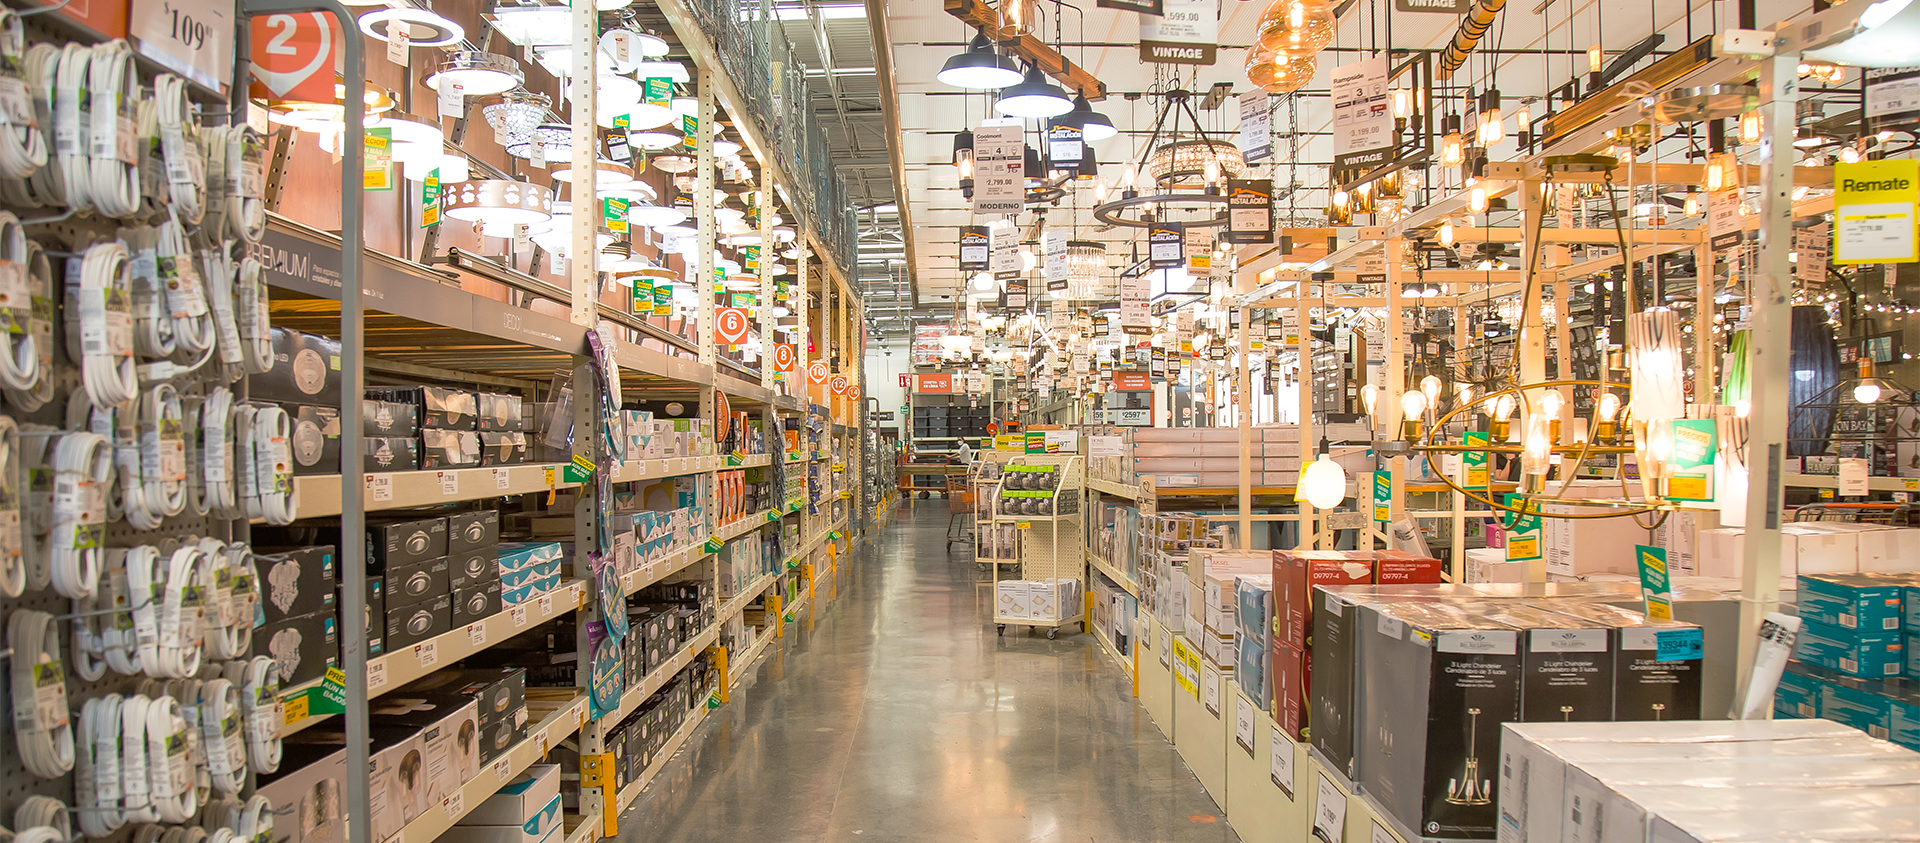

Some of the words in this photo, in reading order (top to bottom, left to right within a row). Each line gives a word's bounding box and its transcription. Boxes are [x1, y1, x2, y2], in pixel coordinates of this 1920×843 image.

[265, 14, 297, 56] 2
[1152, 46, 1203, 59] VINTAGE
[1333, 73, 1364, 84] Rampside
[1356, 88, 1363, 97] 3
[364, 136, 386, 147] ECIOS
[1343, 152, 1383, 166] VINTAGE
[1842, 177, 1910, 192] Remate
[246, 243, 307, 279] PREMIUM
[726, 315, 738, 330] 6
[780, 350, 788, 361] 8
[812, 368, 825, 377] 10
[850, 388, 858, 396] 14
[1850, 420, 1867, 431] BAY
[1678, 429, 1710, 444] PRECIOS
[1313, 572, 1340, 580] 09797-4
[327, 670, 346, 684] PRE
[1444, 667, 1478, 675] Candelabro
[322, 681, 340, 694] AÚN
[322, 690, 347, 706] BAJOS
